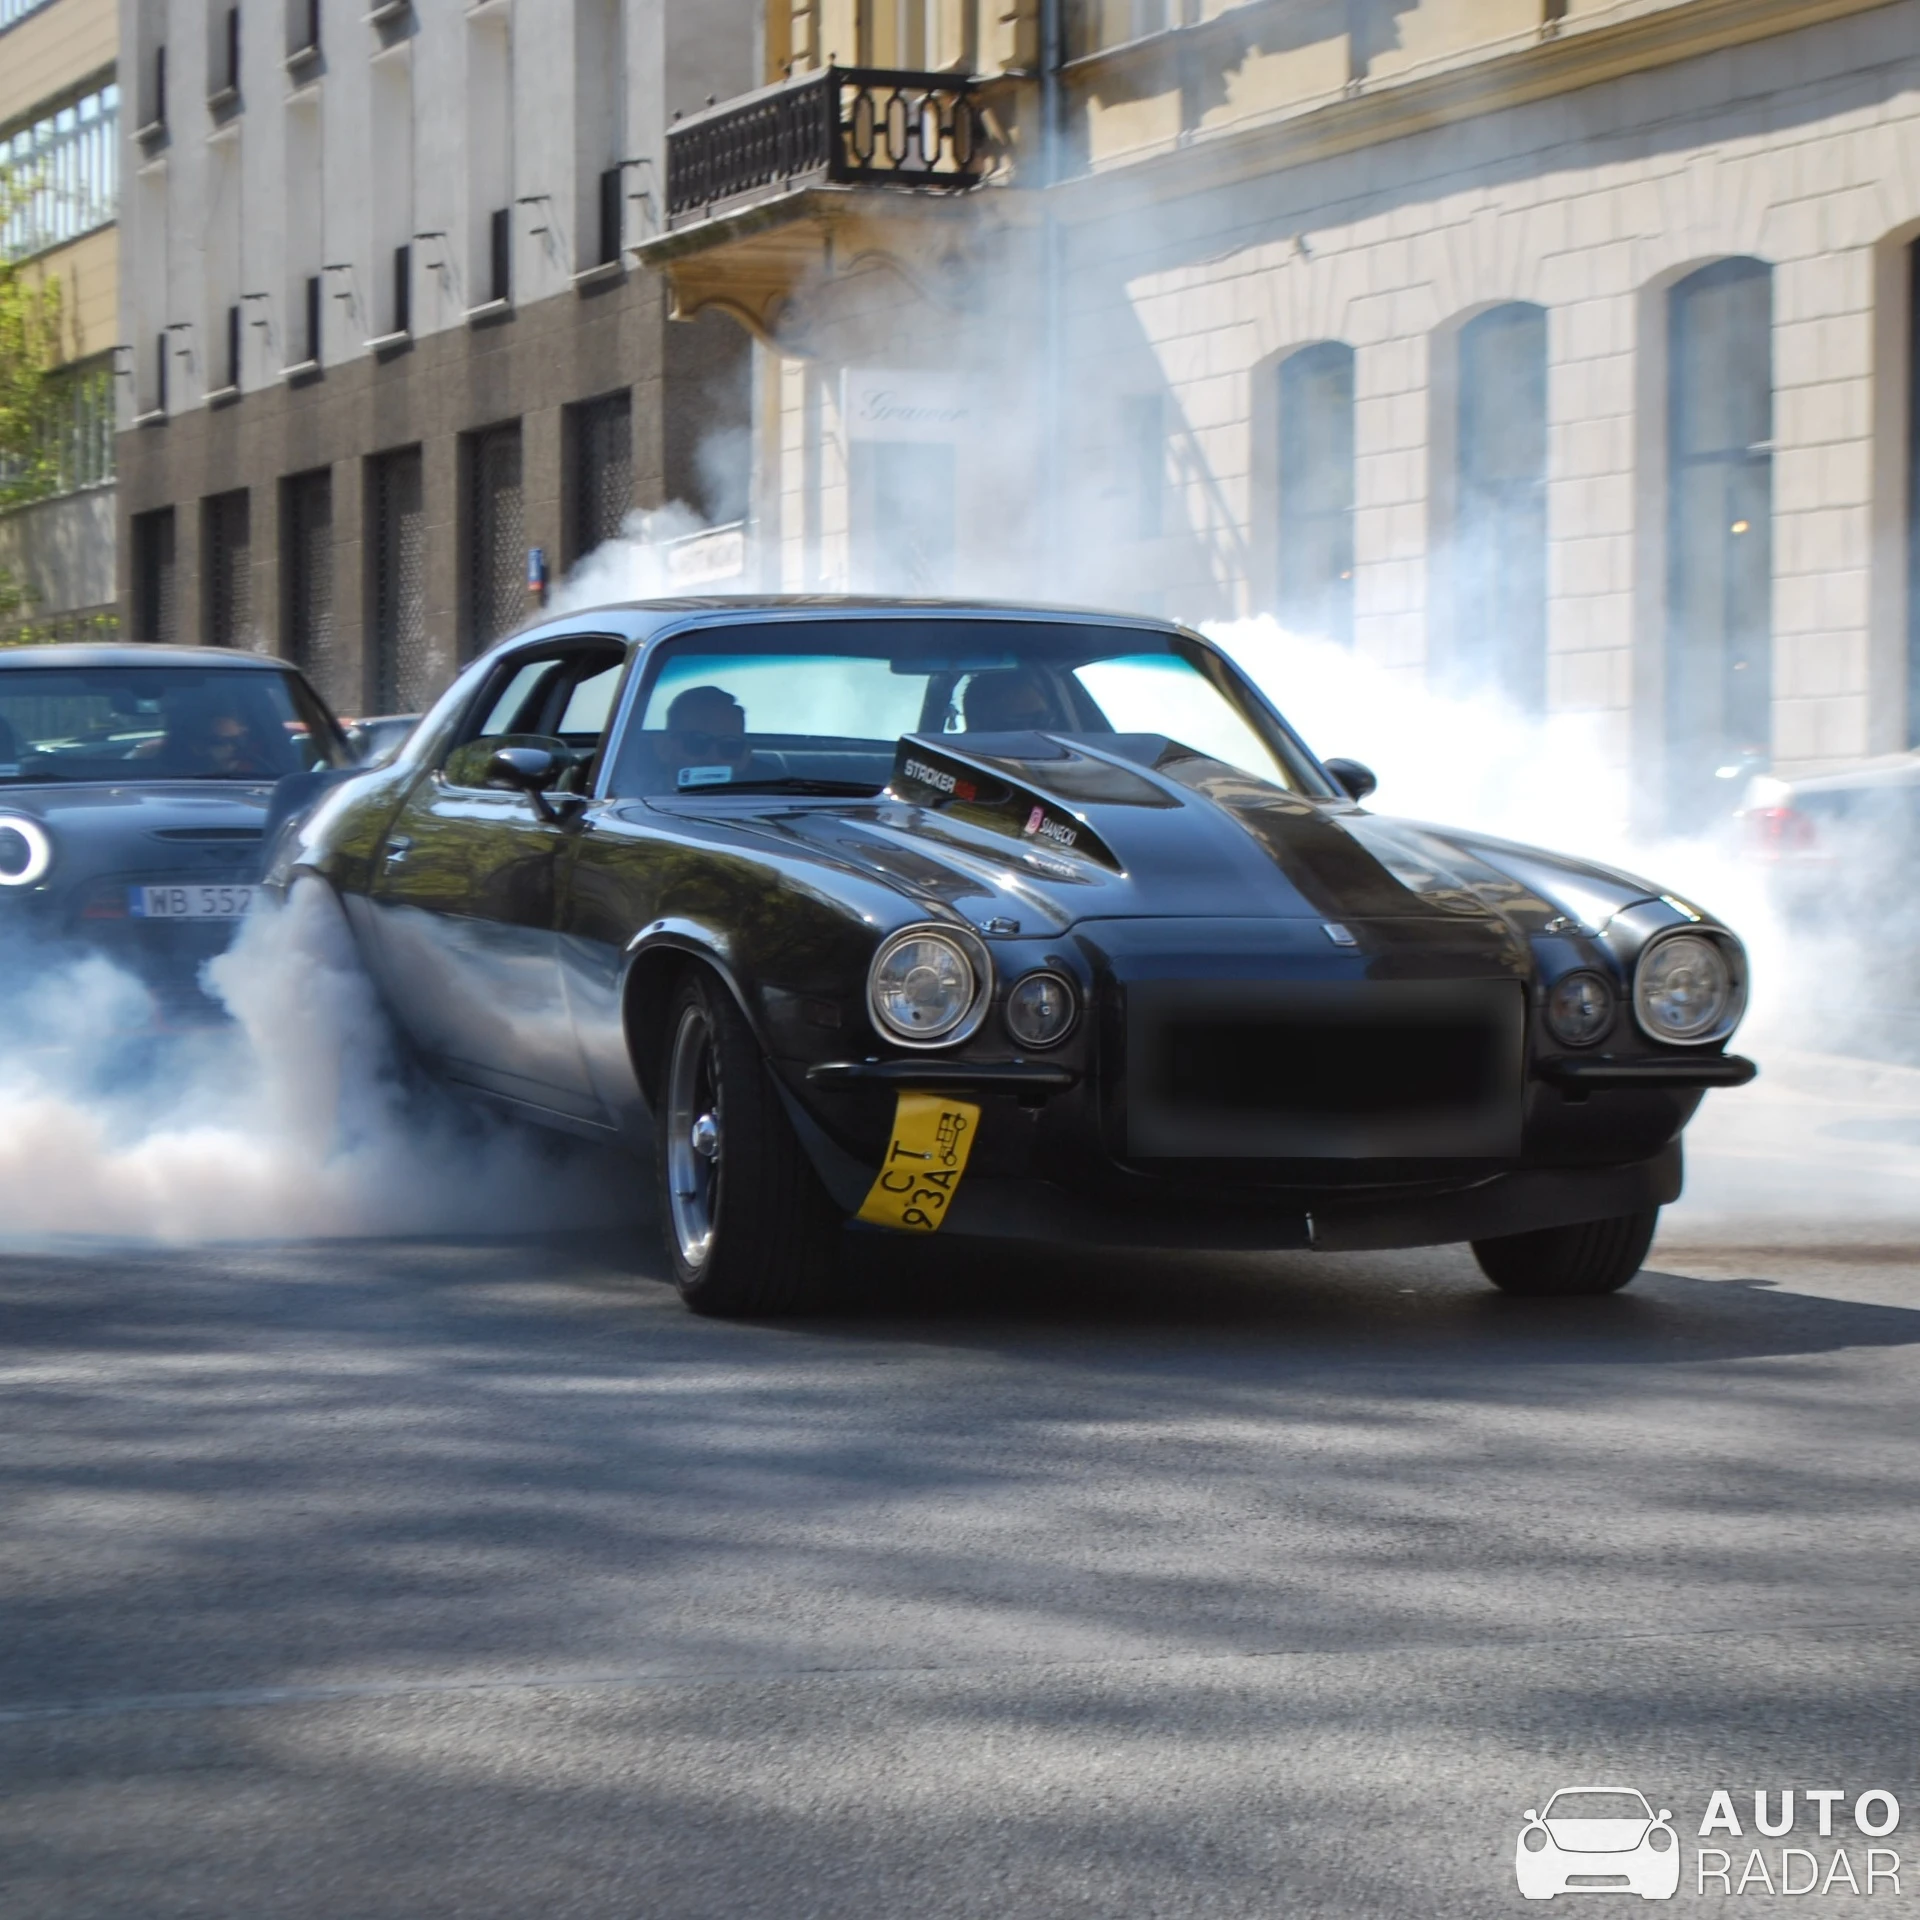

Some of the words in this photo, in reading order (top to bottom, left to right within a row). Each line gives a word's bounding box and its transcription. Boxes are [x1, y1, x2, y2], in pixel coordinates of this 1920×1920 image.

[904, 758, 956, 793] STROKER
[149, 888, 188, 914] WB
[881, 1140, 931, 1193] CT
[902, 1169, 958, 1229] 93A
